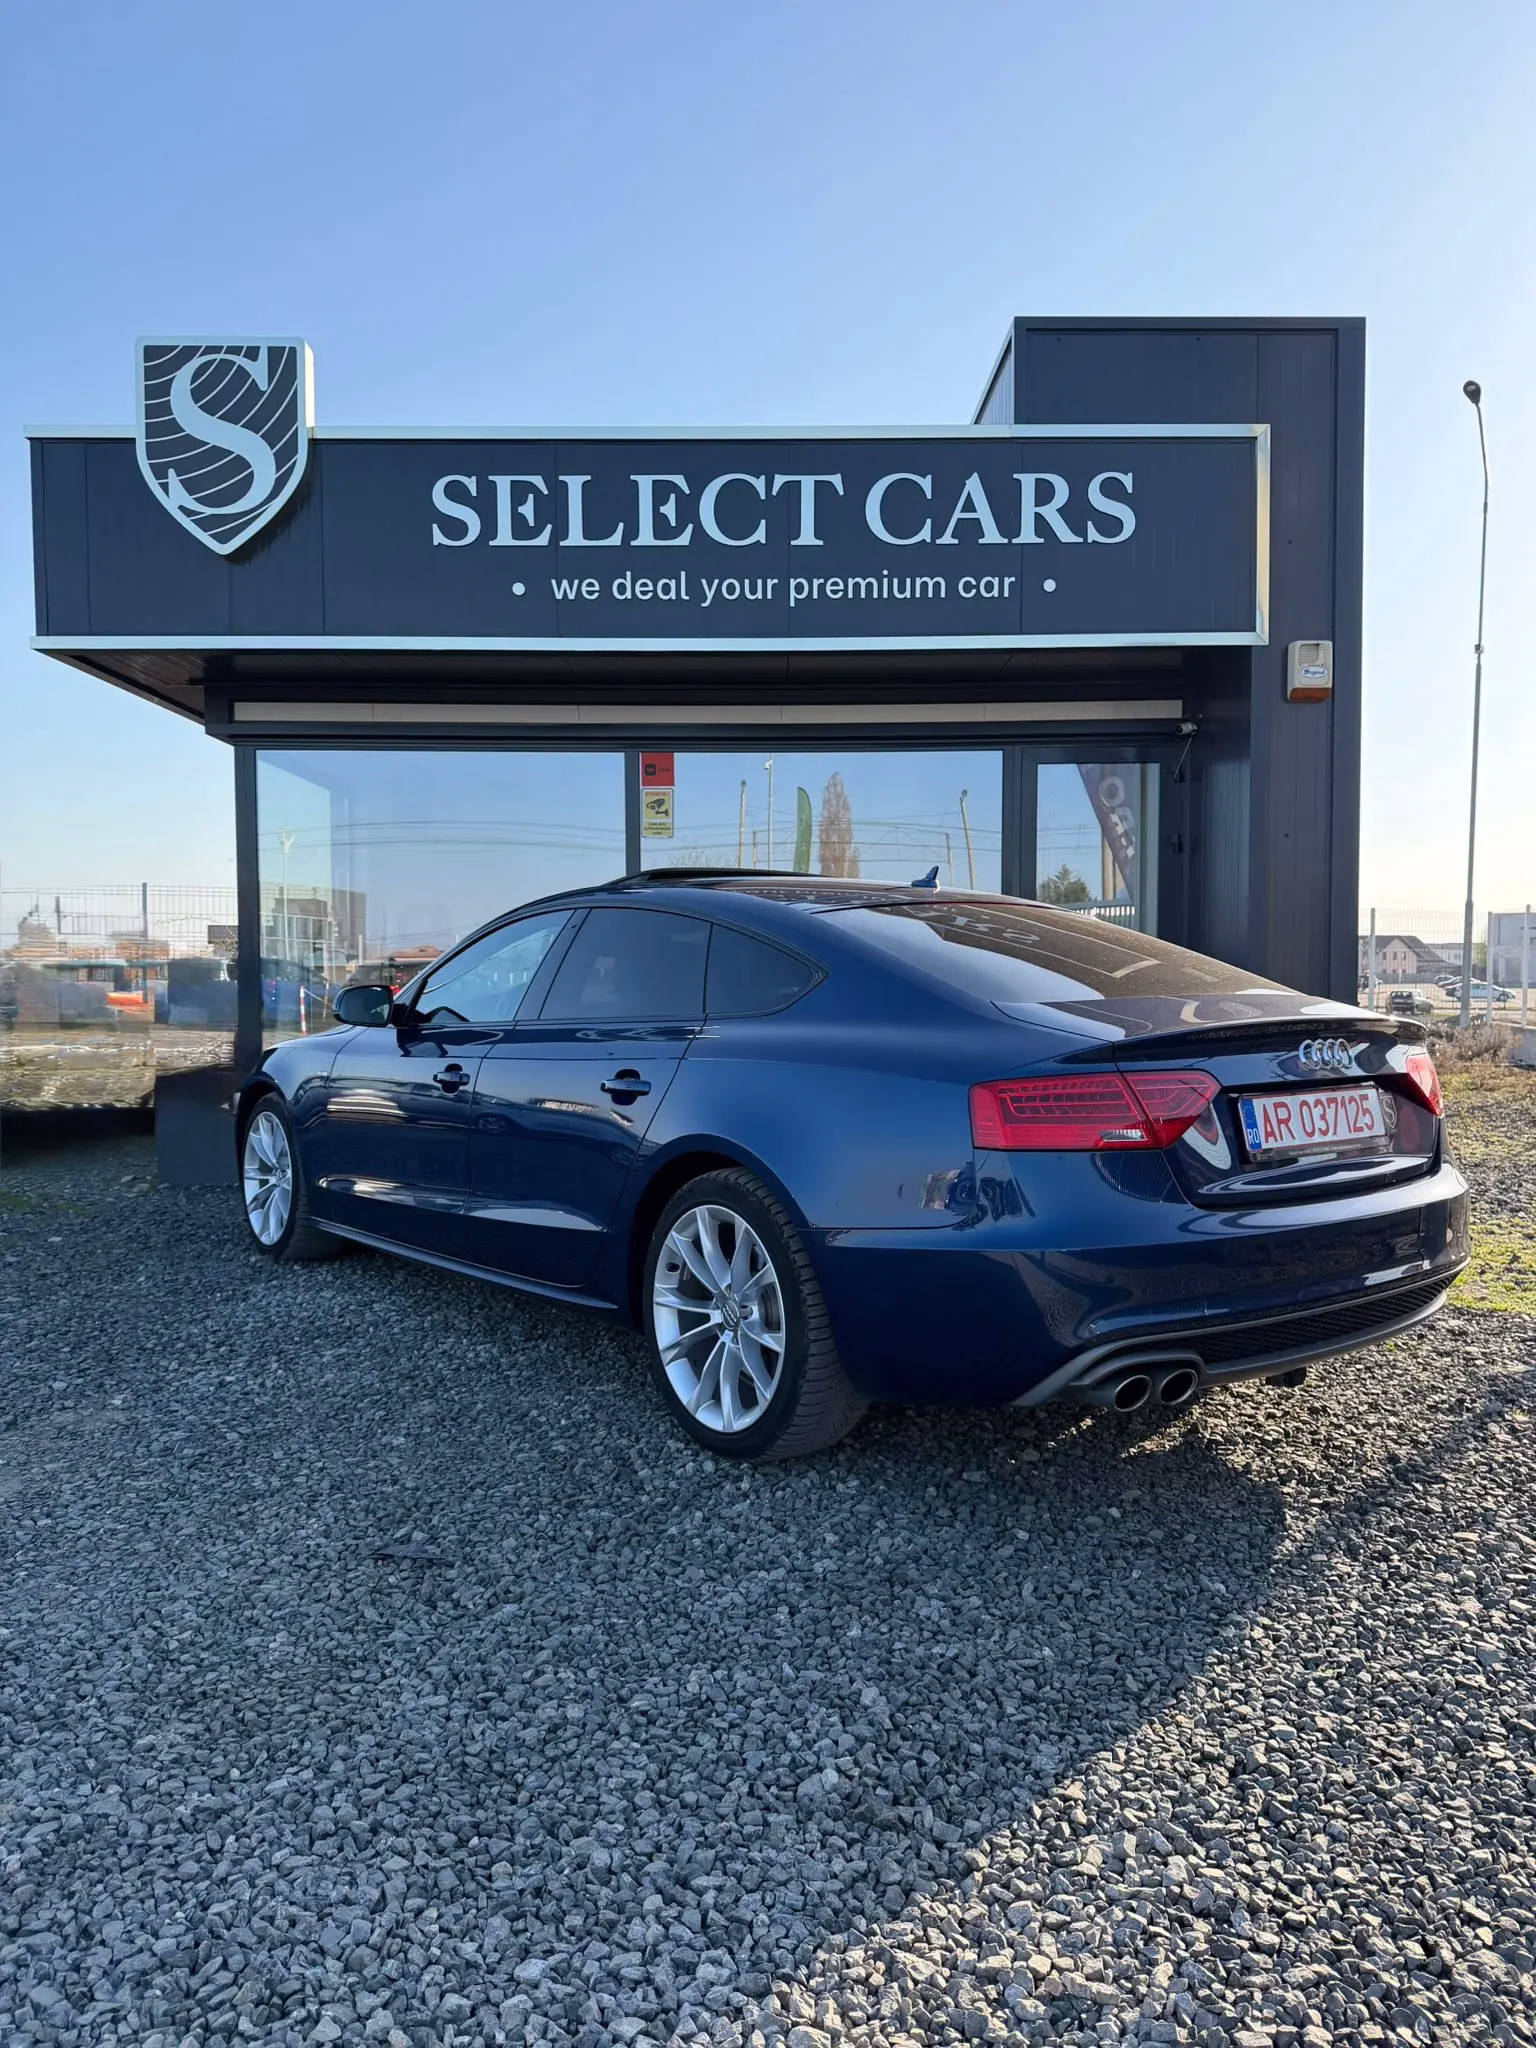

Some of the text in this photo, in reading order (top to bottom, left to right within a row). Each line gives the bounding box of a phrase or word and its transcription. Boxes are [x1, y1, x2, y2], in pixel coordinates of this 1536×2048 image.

[168, 345, 276, 514] S
[431, 472, 1137, 547] SELECT CARS
[551, 569, 1016, 607] we deal your premium car
[1247, 1128, 1260, 1145] RO
[1263, 1093, 1376, 1144] AR 037125
